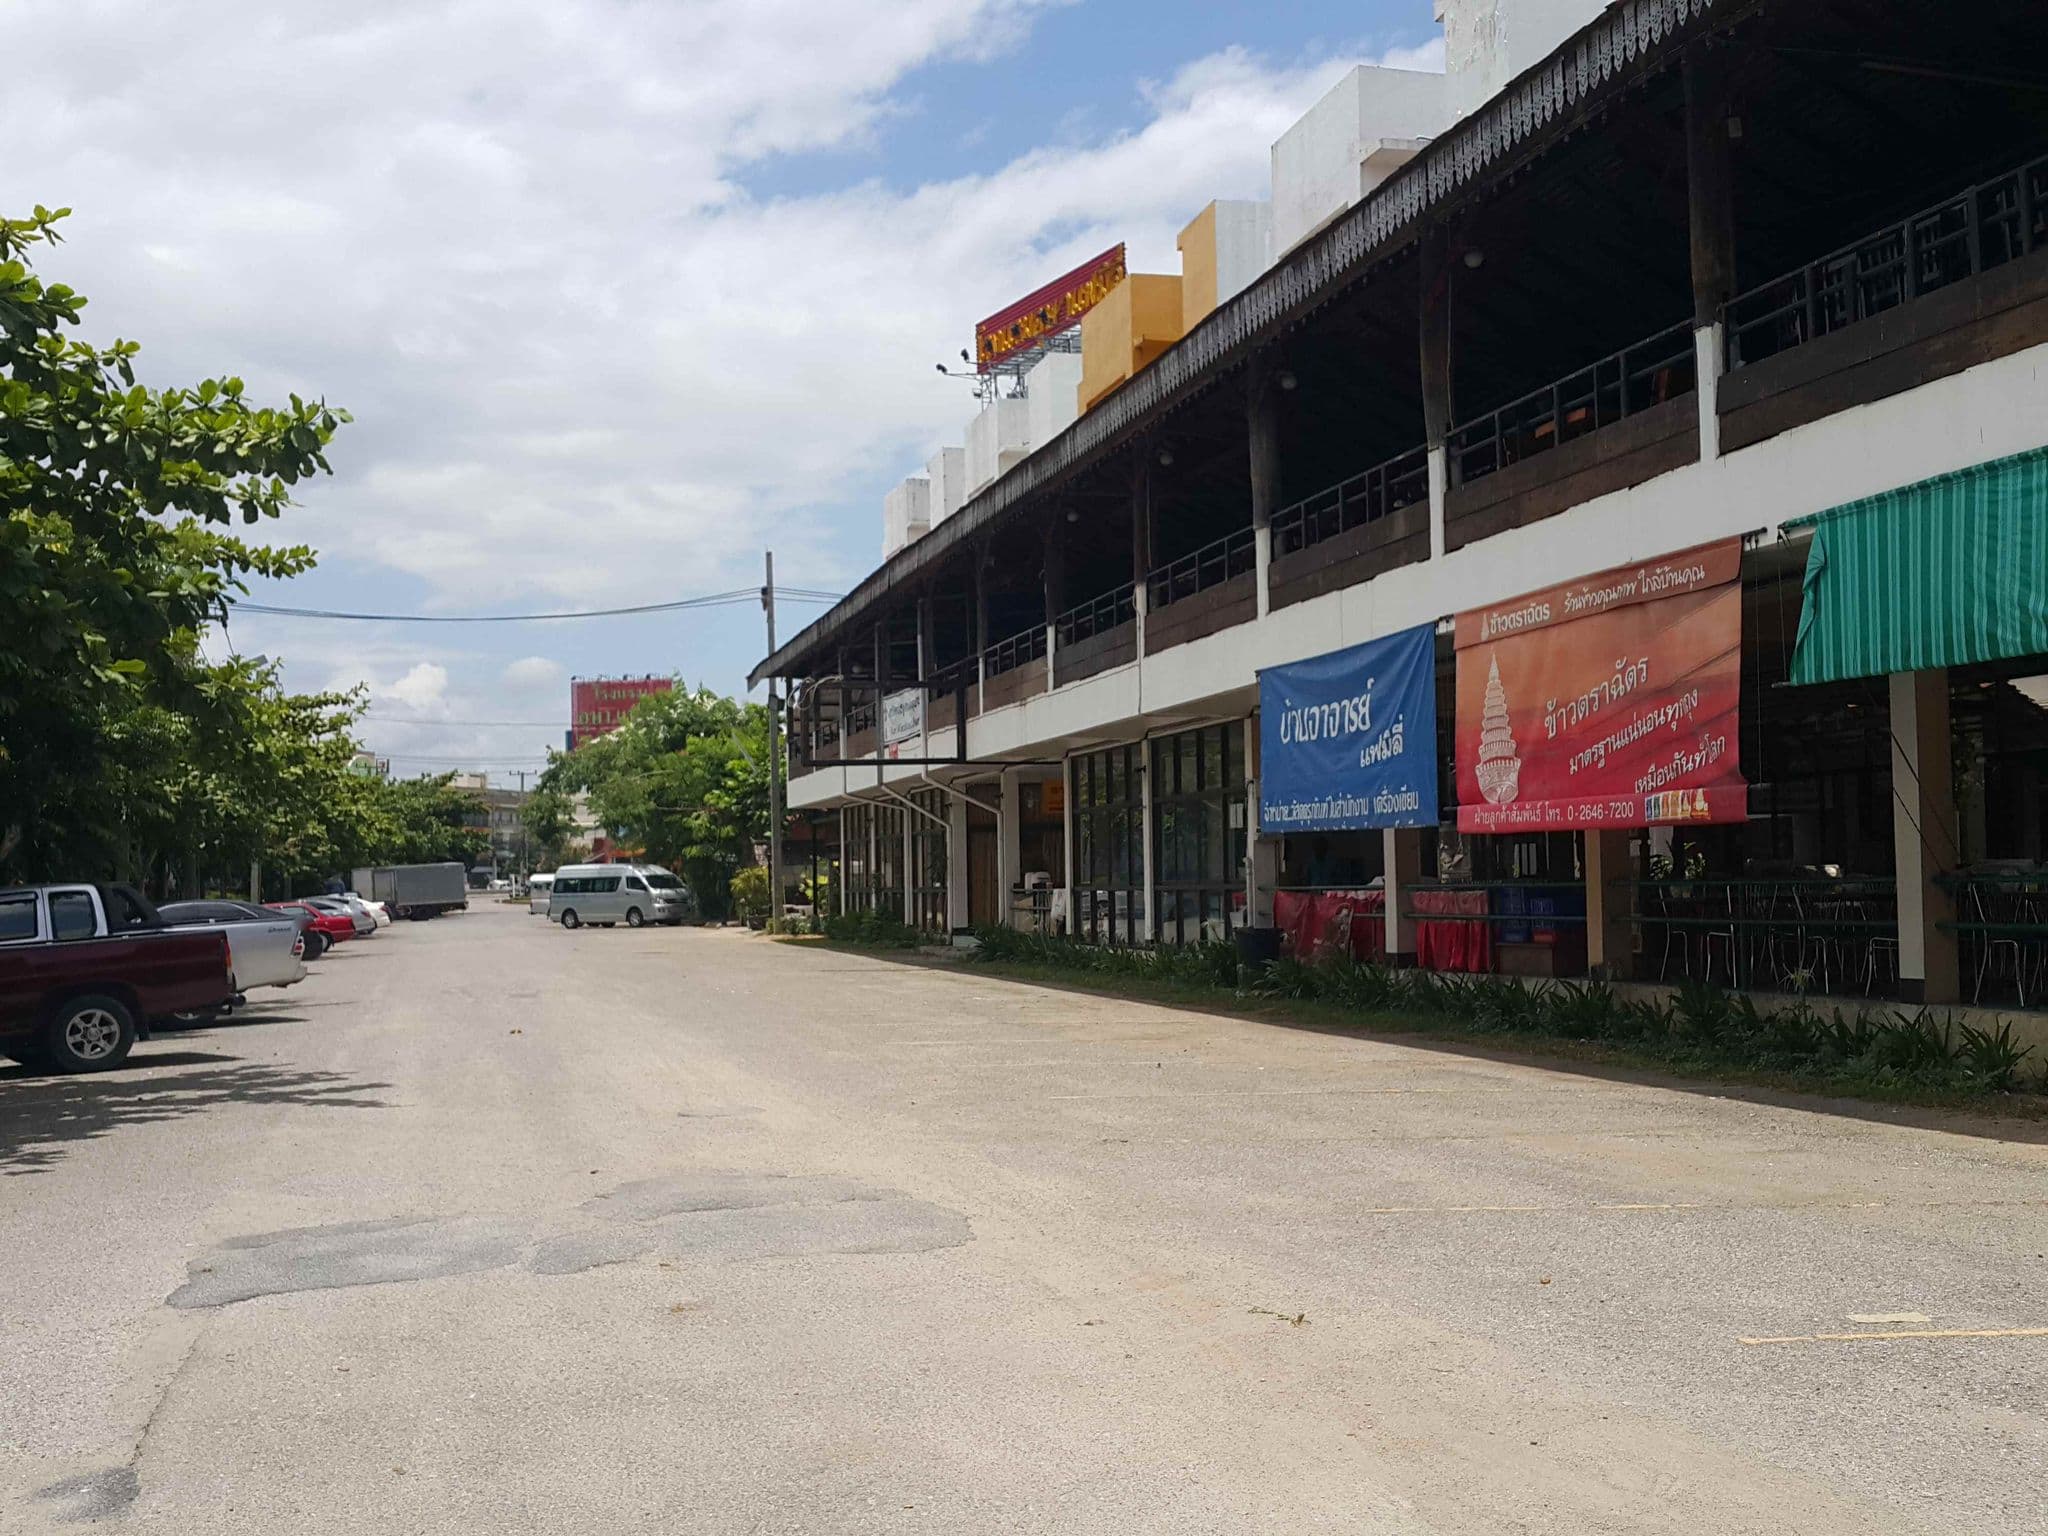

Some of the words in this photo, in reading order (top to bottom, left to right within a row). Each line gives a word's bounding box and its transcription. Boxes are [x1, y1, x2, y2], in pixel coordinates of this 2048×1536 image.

[1544, 655, 1649, 740] ข้าวตราฉัตร
[1567, 801, 1634, 821] 0-2646-7200
